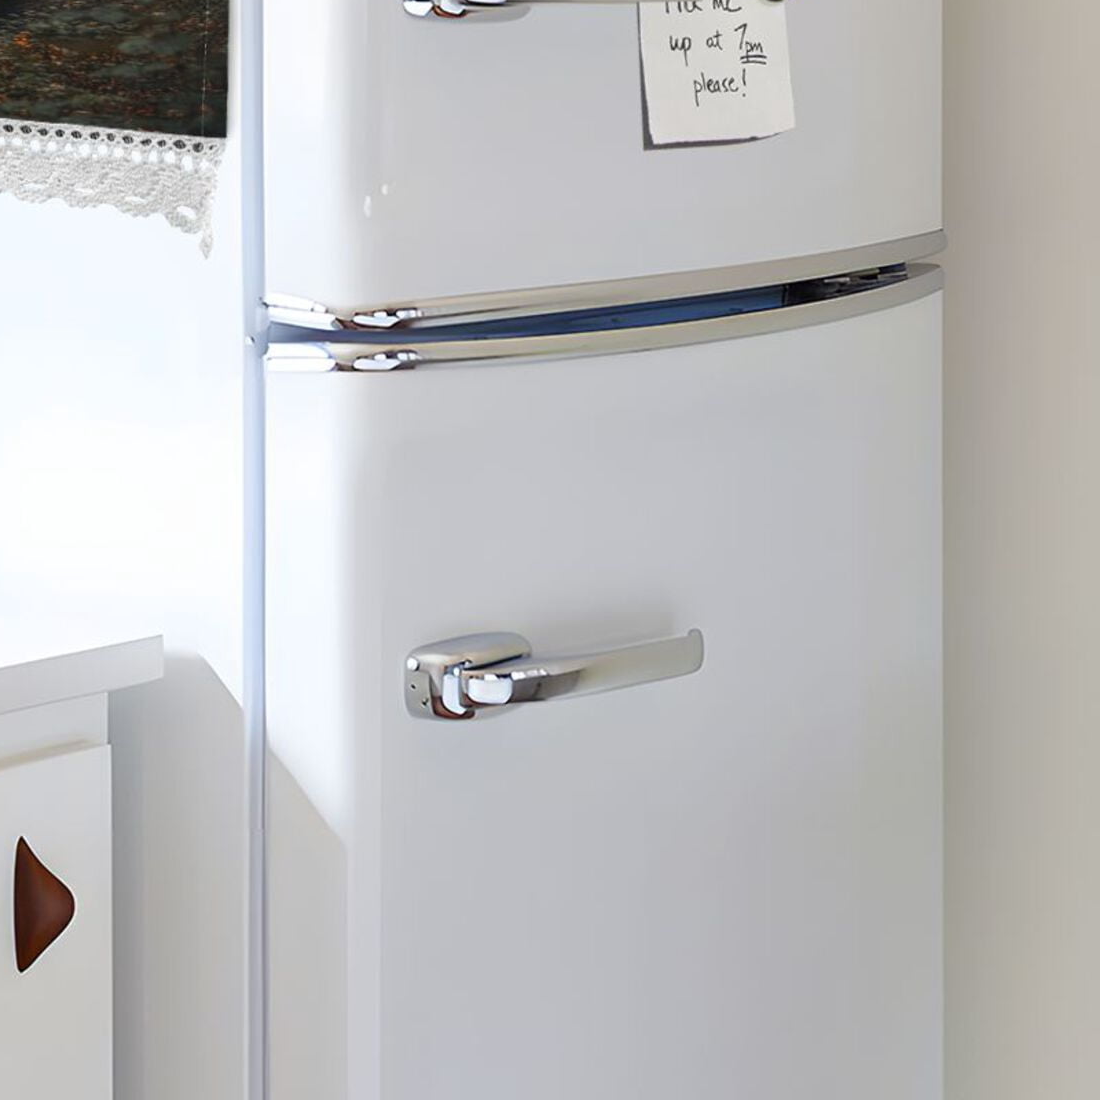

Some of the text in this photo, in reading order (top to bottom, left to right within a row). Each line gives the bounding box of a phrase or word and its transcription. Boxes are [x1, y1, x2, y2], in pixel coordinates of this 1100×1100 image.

[669, 35, 692, 67] up
[706, 30, 723, 51] at
[693, 68, 747, 107] please!
